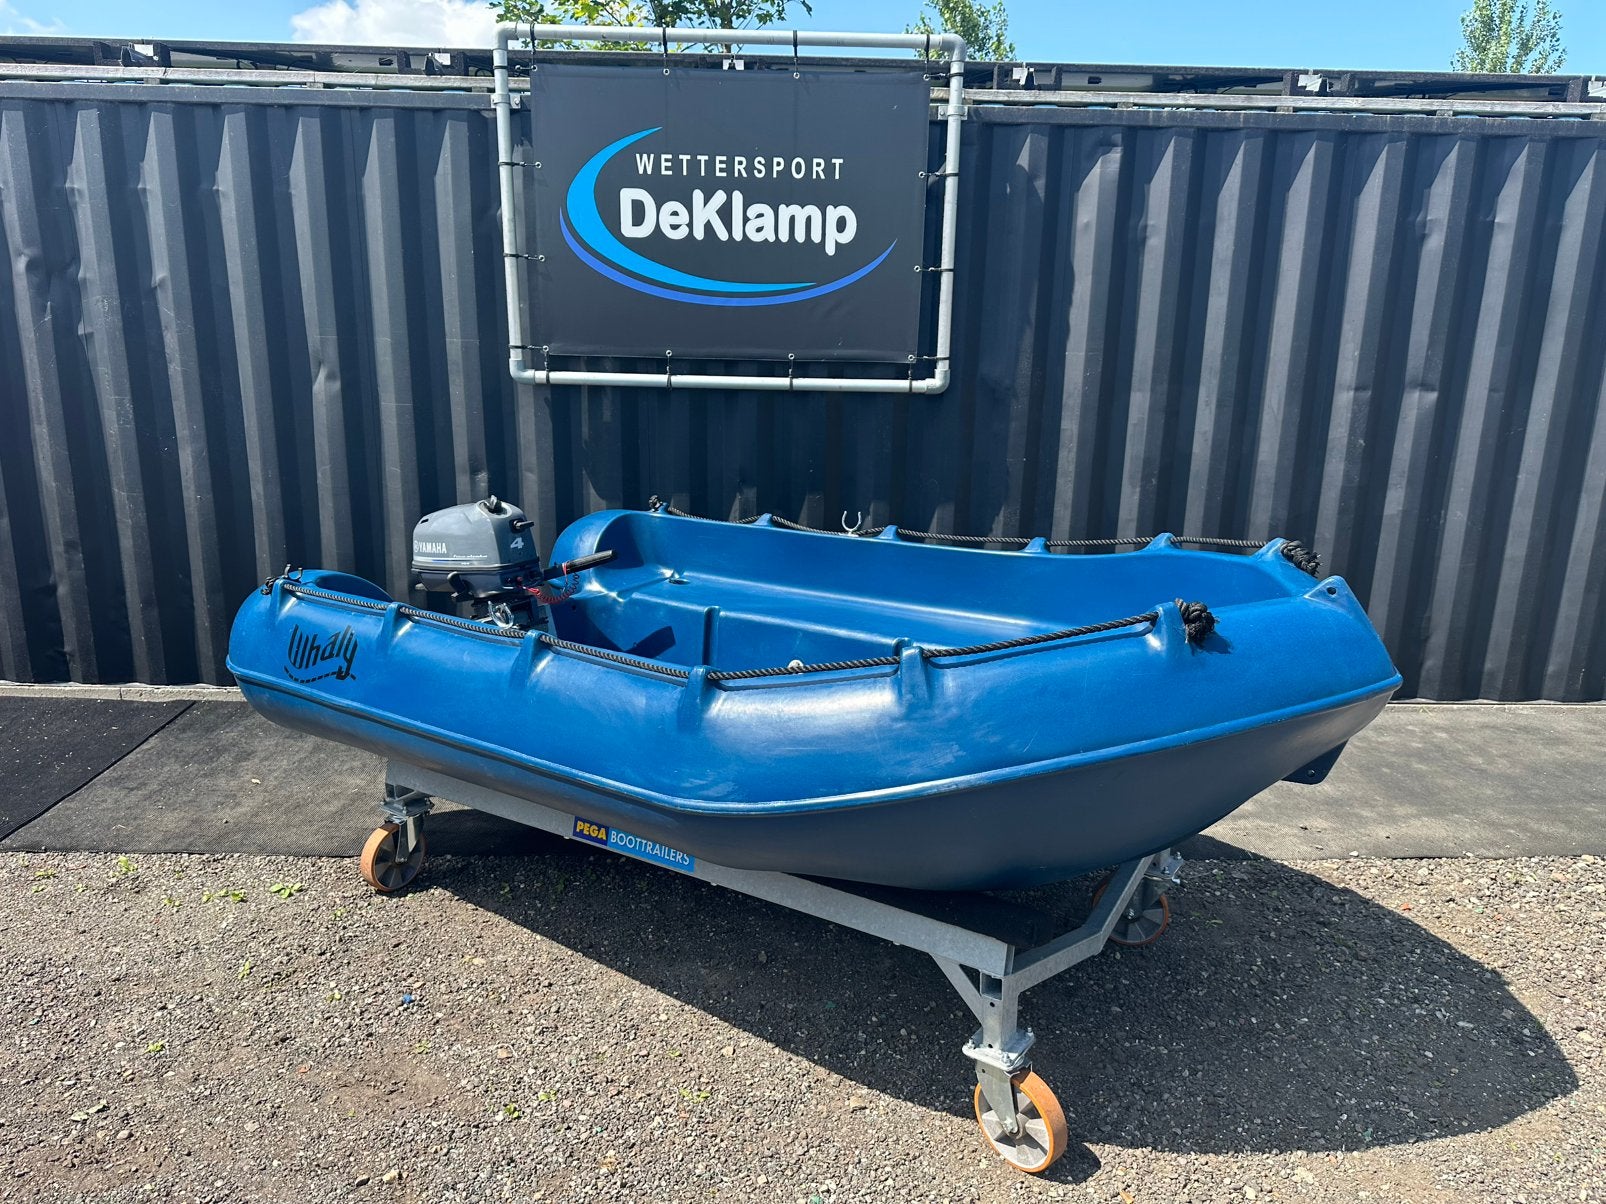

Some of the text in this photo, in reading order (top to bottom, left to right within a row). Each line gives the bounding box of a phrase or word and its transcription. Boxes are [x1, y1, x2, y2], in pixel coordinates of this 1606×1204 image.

[635, 153, 844, 180] WETTERSPORT
[619, 187, 858, 256] DeKlamp
[419, 541, 447, 554] YAMAHA
[510, 536, 525, 549] 4
[288, 624, 358, 680] Whaly
[576, 820, 690, 865] PEGA BOOTTRAILERS
